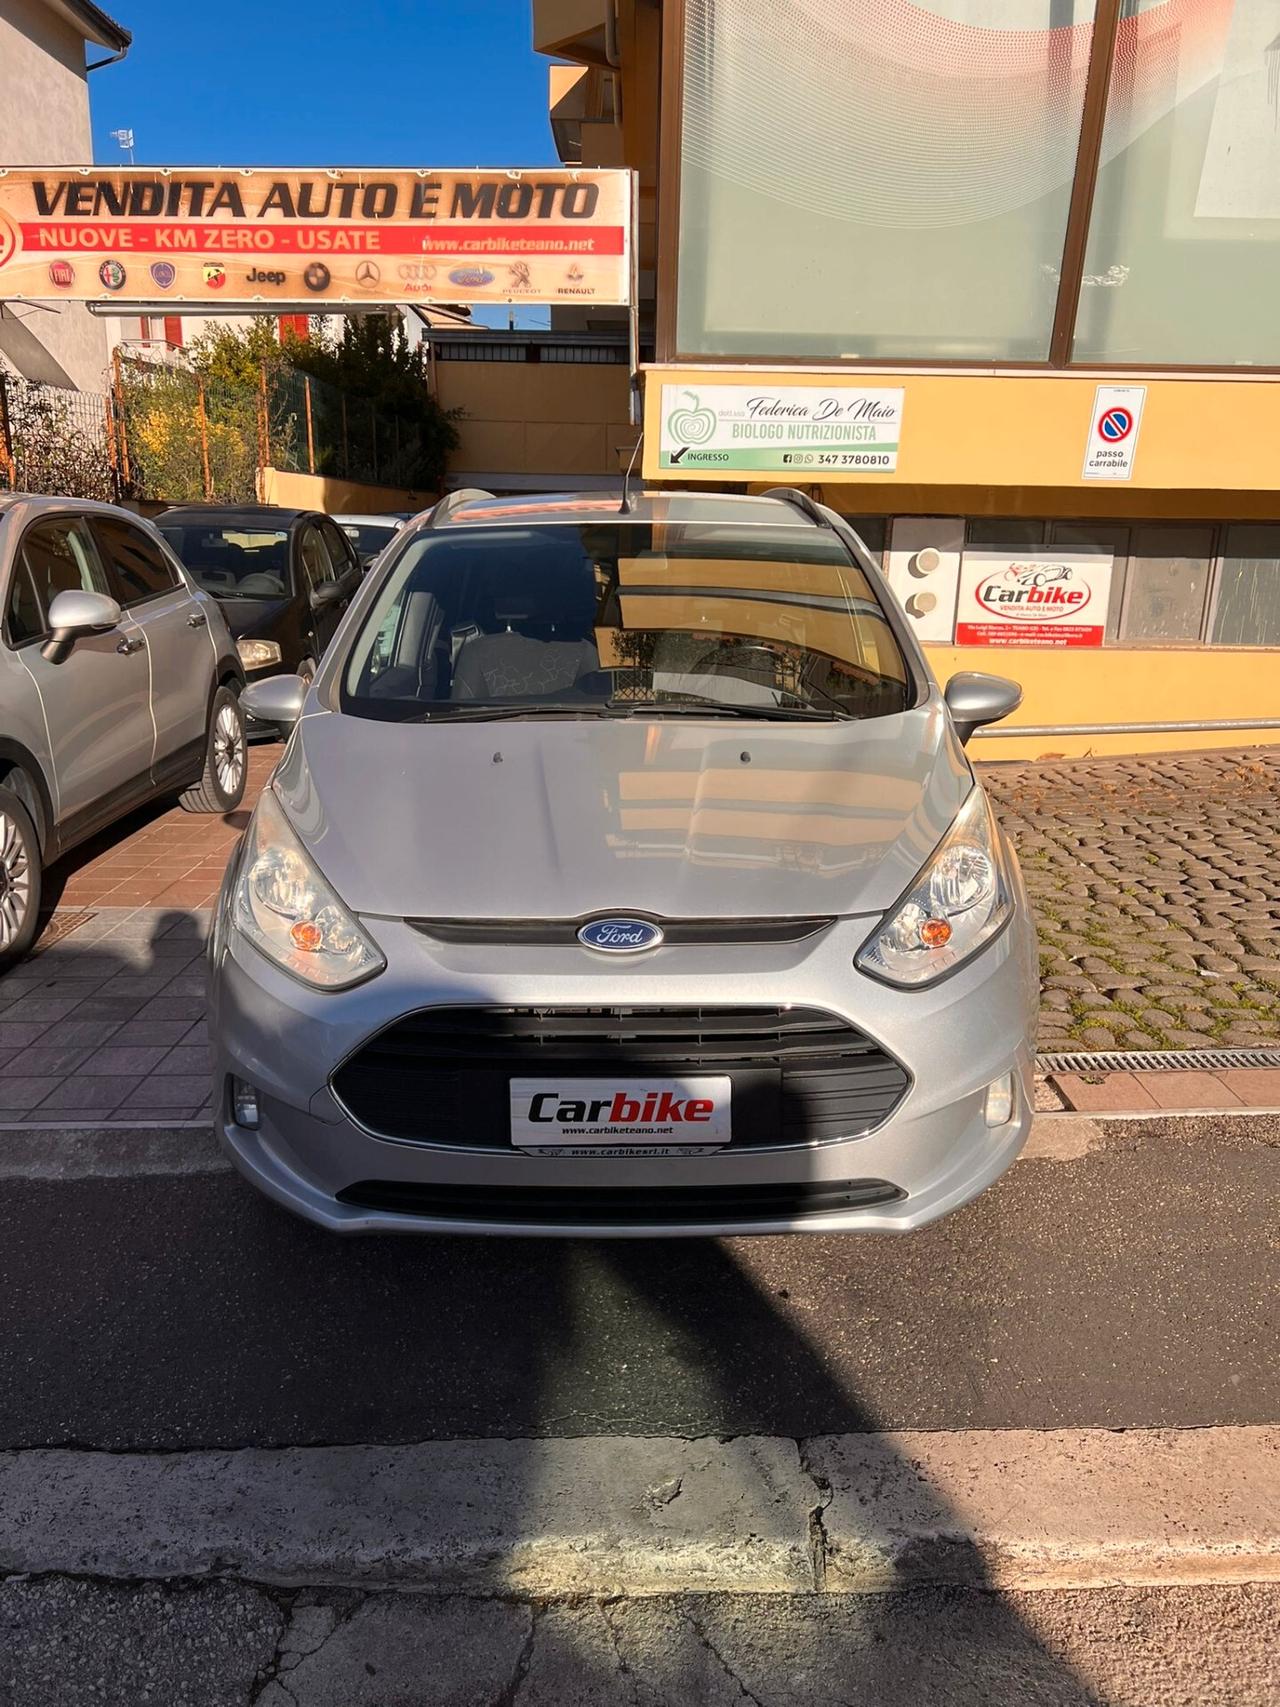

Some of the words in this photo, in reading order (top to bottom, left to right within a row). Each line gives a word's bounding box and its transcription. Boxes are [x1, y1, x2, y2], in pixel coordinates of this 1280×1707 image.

[32, 181, 246, 218] VENDITA
[257, 182, 398, 219] AUTO
[409, 183, 442, 219] E
[450, 182, 600, 219] MOTO
[39, 227, 134, 248] NUOVE
[155, 229, 197, 249] KM
[203, 229, 275, 250] ZERO
[297, 230, 381, 251] USATE
[422, 236, 594, 252] www.carbiketeano.net
[246, 268, 287, 286] Jeep
[404, 283, 433, 292] Audi
[746, 396, 809, 419] Federica
[812, 398, 843, 421] De
[847, 398, 896, 421] Maio
[732, 423, 784, 439] BIOLOGO
[788, 424, 877, 441] NUTRIZIONISTA
[687, 453, 729, 462] INGRESSO
[818, 455, 838, 464] 347
[841, 455, 890, 465] 3780810
[1096, 450, 1124, 458] passo
[1089, 459, 1128, 467] carrabile
[983, 585, 1084, 604] Carbike
[597, 925, 643, 944] Ford
[528, 1092, 714, 1123] Carbike
[562, 1126, 674, 1135] www.carbiketeano.net
[571, 1147, 670, 1156] www.carbikesrl.it
